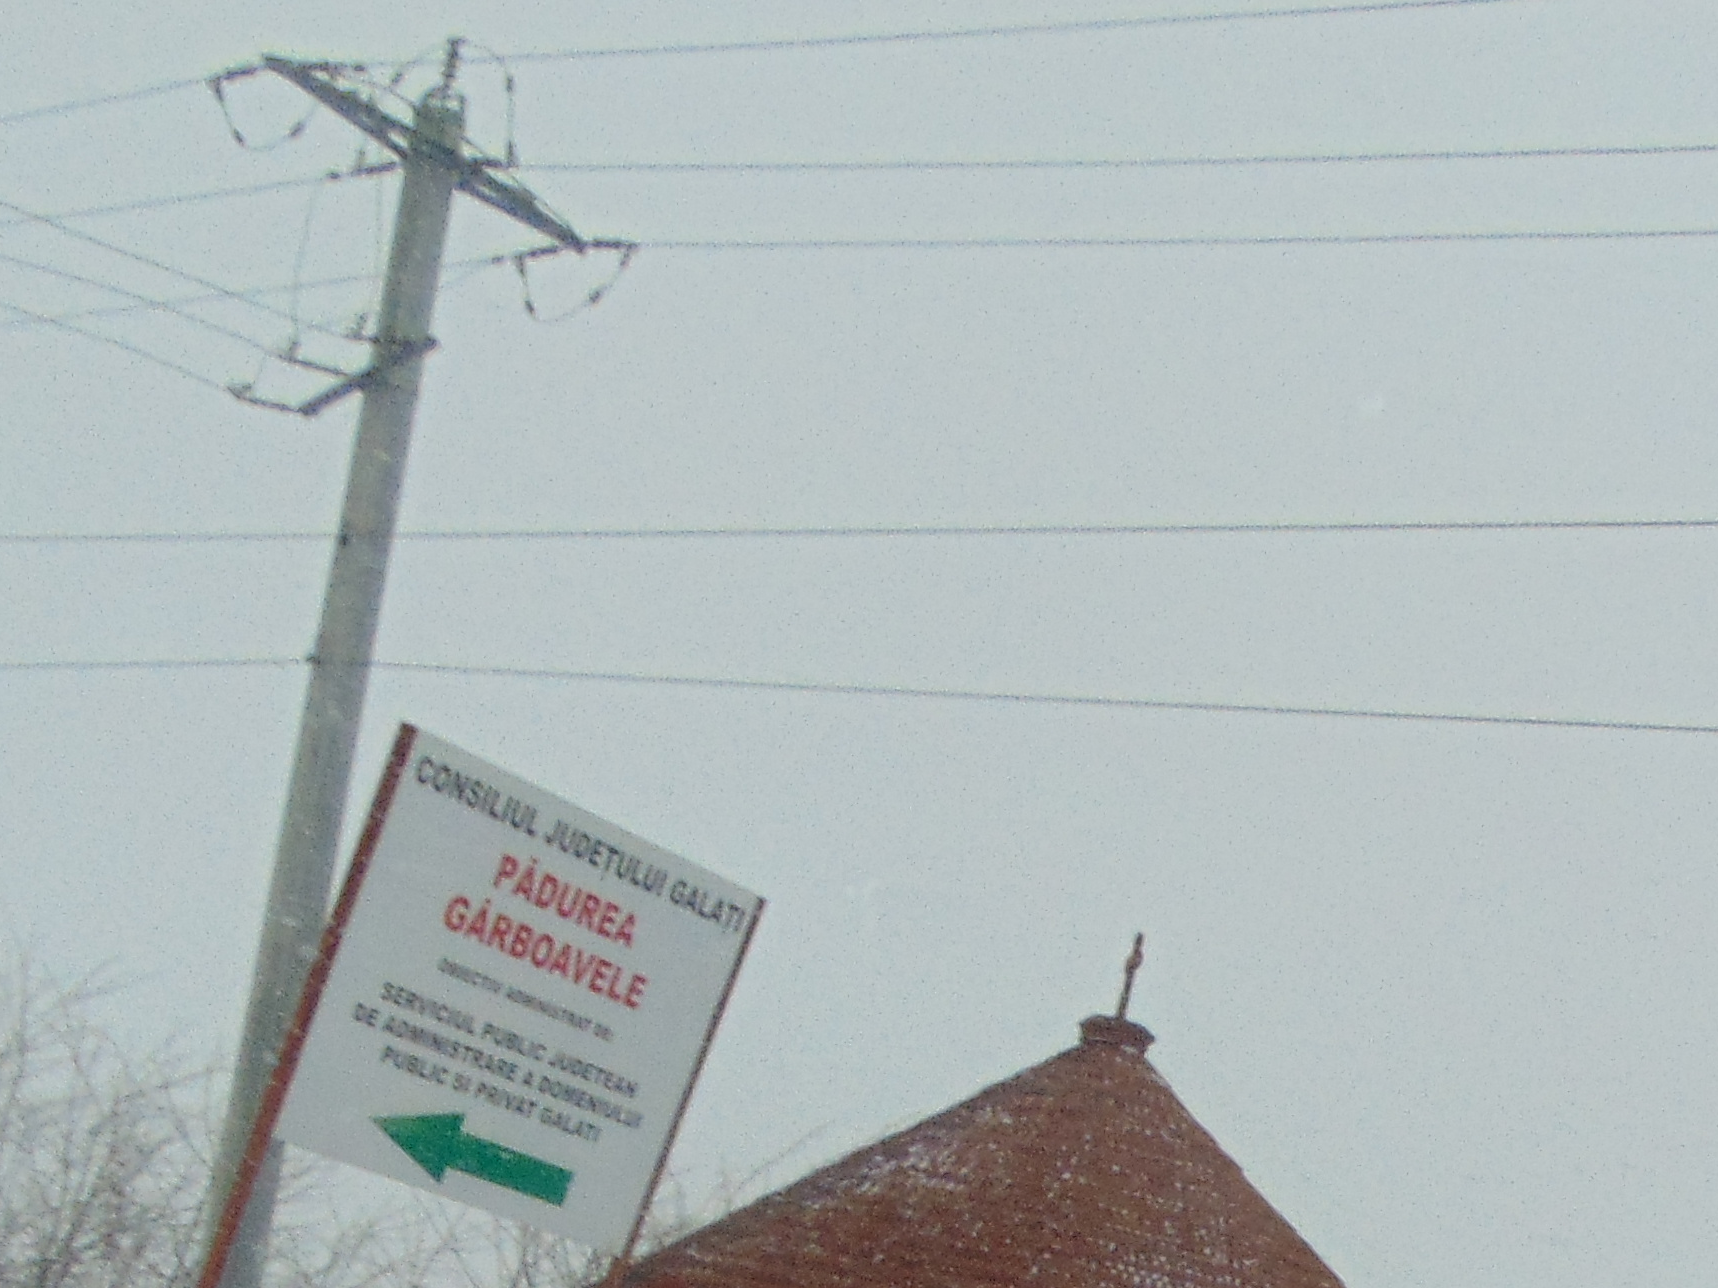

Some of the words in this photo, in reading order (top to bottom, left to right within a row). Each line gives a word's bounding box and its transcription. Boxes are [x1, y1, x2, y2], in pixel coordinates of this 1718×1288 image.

[415, 755, 539, 836] CONSILIUL
[493, 852, 638, 949] PĂDUREA
[353, 1002, 381, 1028] DE
[382, 1014, 519, 1083] ADMINISTRARE
[522, 1069, 535, 1087] A
[380, 981, 476, 1036] SERVICIUL
[481, 1020, 548, 1062] PUBLIC
[381, 1044, 449, 1085] PUBLIC
[476, 1082, 538, 1119] PRIVAT
